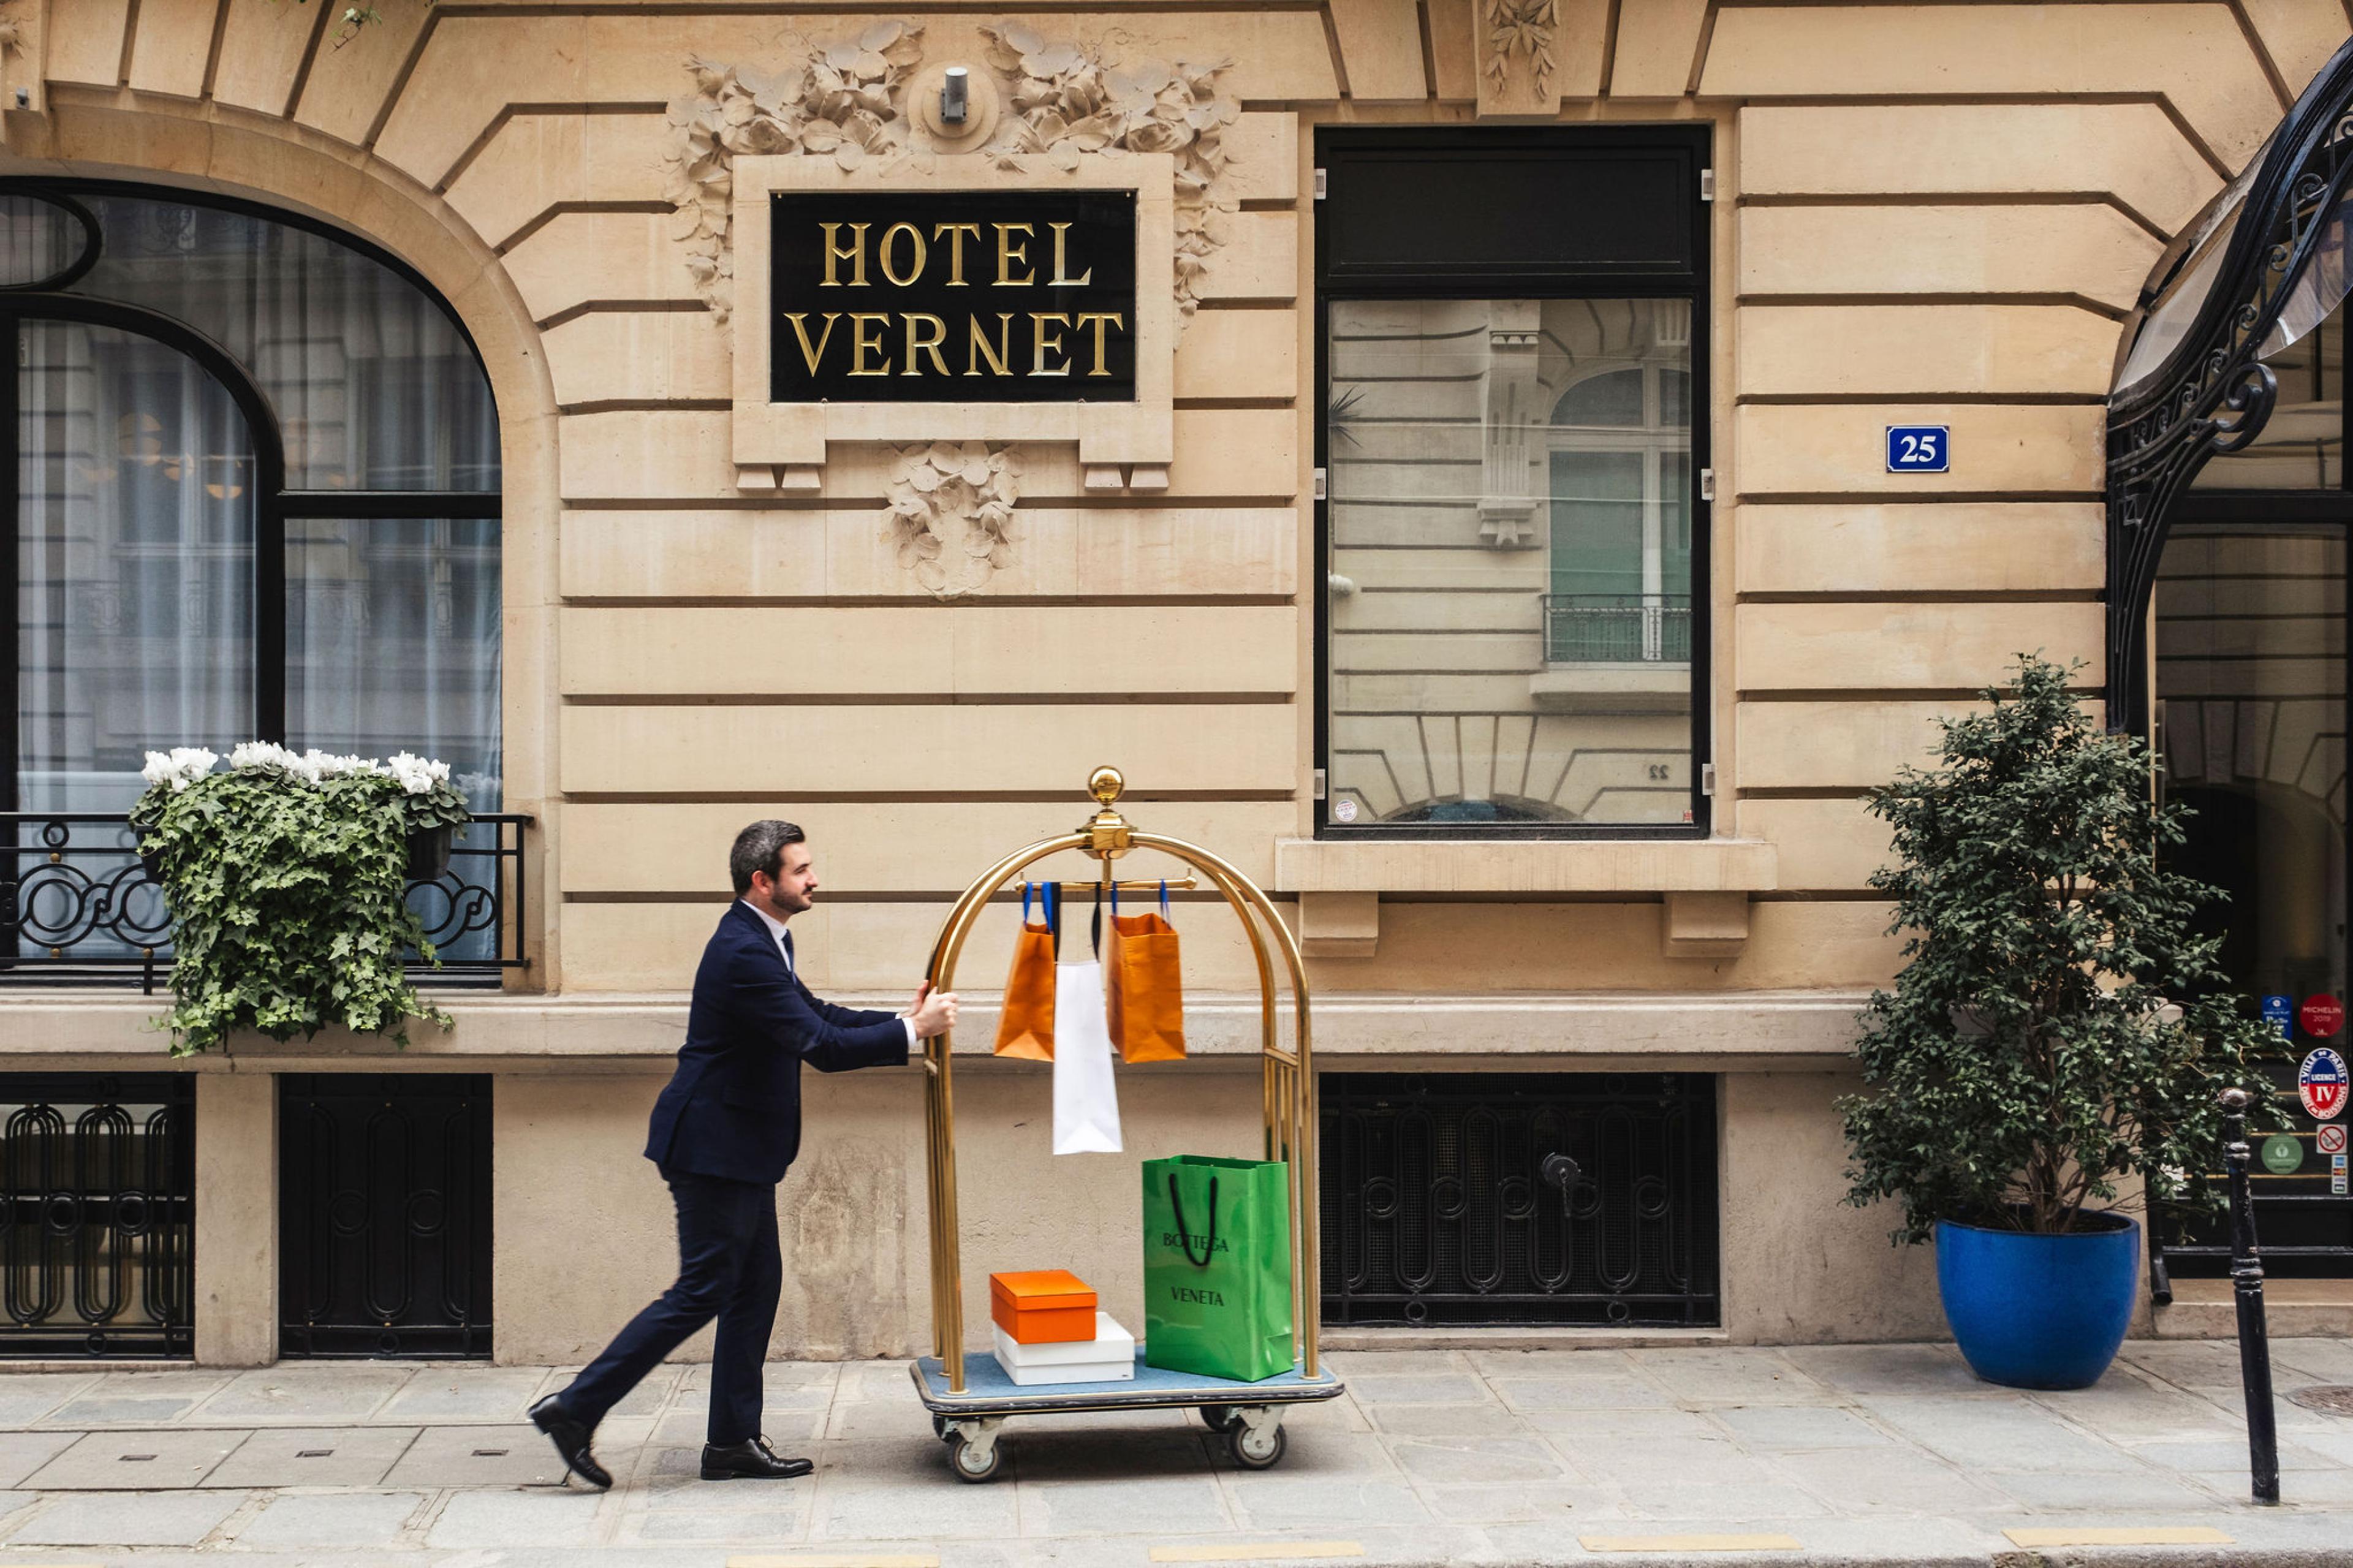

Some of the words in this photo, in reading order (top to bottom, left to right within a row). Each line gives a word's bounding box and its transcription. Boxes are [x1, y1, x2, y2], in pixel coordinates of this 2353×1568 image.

[819, 221, 1091, 286] HOTEL
[783, 312, 1123, 377] VERNET
[1900, 436, 1936, 463] 25
[2301, 1055, 2317, 1077] VILLE
[2329, 1052, 2346, 1077] PARIS
[2316, 1086, 2335, 1102] IV
[1171, 1286, 1224, 1306] VENETA
